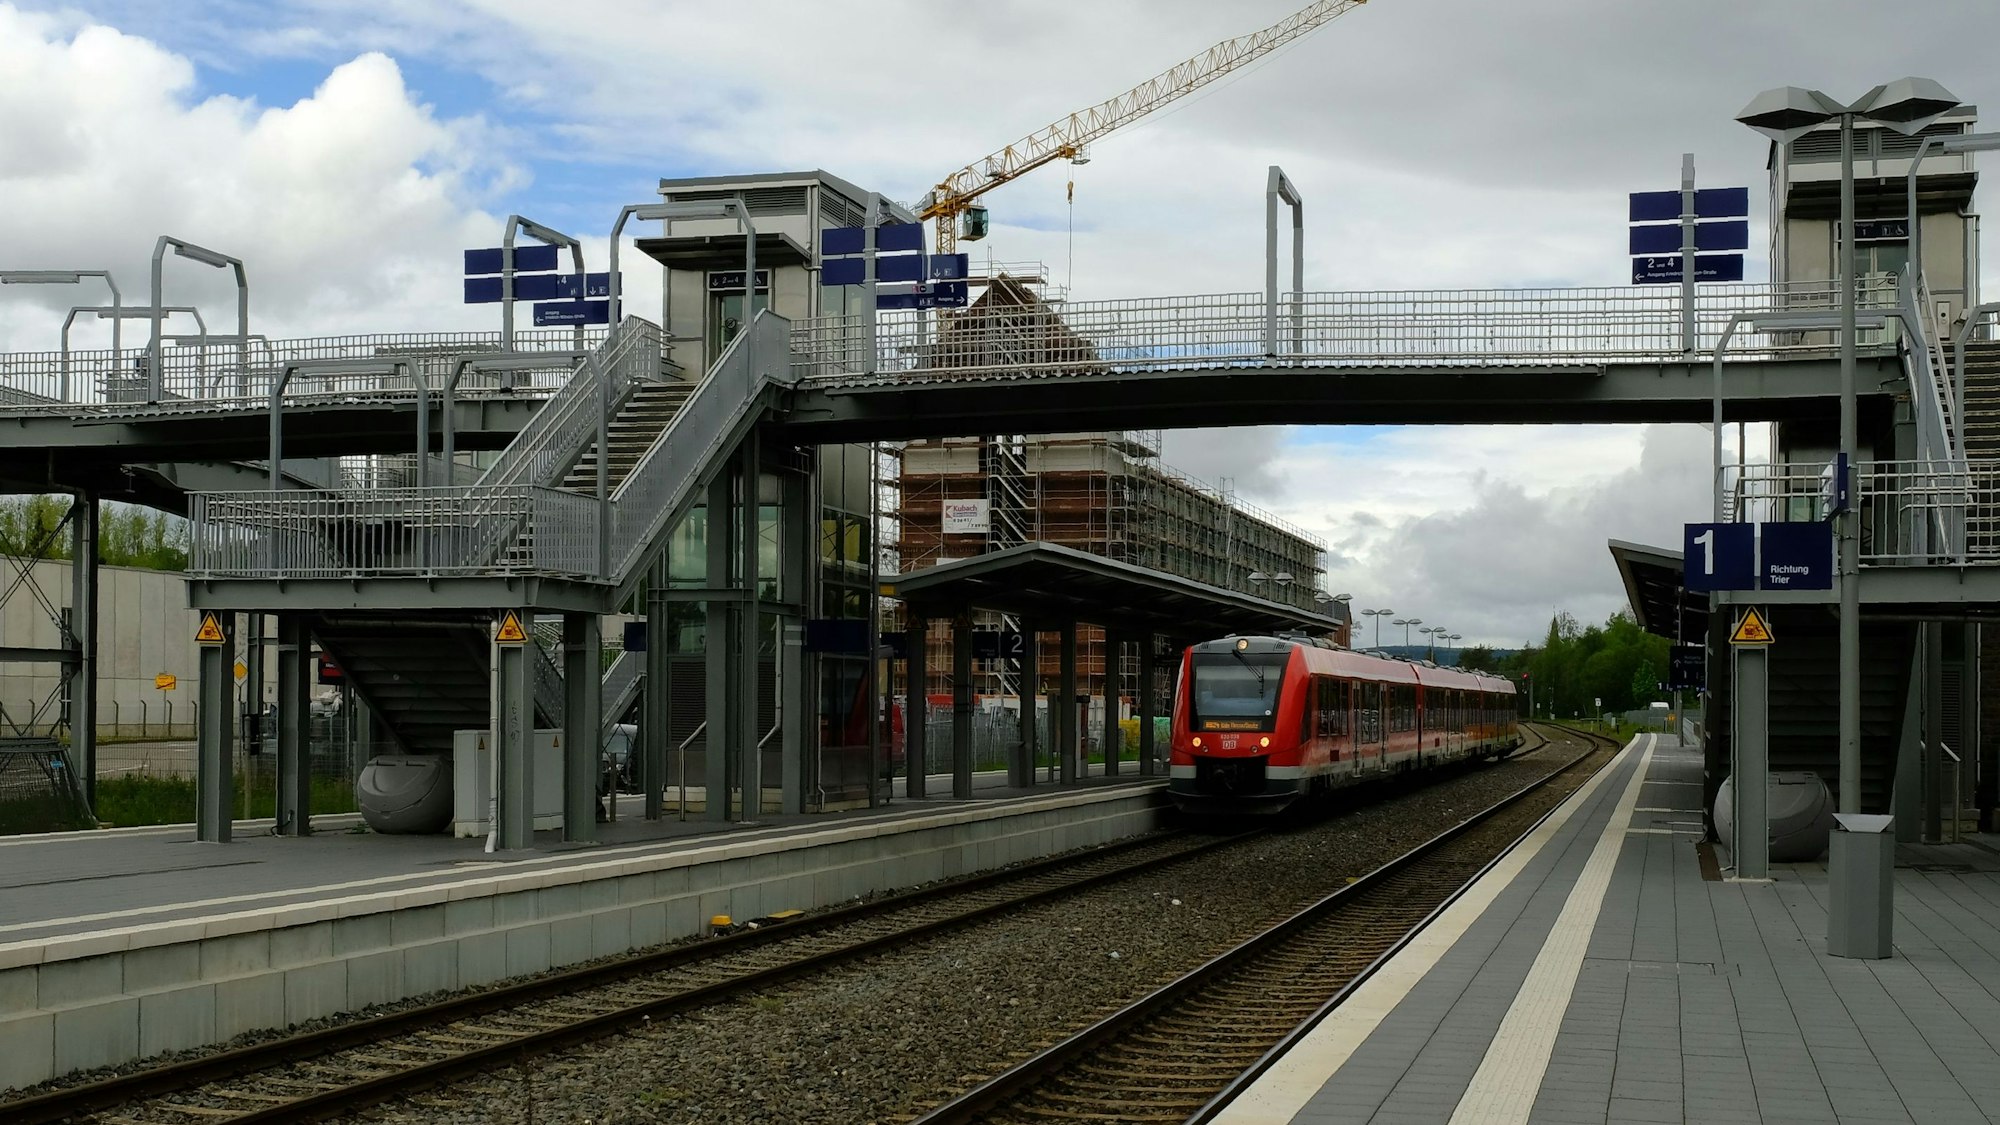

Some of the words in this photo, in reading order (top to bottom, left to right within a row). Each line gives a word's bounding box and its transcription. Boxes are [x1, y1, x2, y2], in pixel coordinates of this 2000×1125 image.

[1647, 258, 1655, 268] 2
[1667, 257, 1674, 267] 4
[561, 276, 567, 284] 4
[949, 283, 954, 293] 1
[1693, 529, 1714, 575] 1
[1770, 565, 1809, 575] Richtung
[1770, 575, 1790, 584] Trier
[1011, 634, 1023, 653] 2
[1223, 741, 1236, 749] DB
